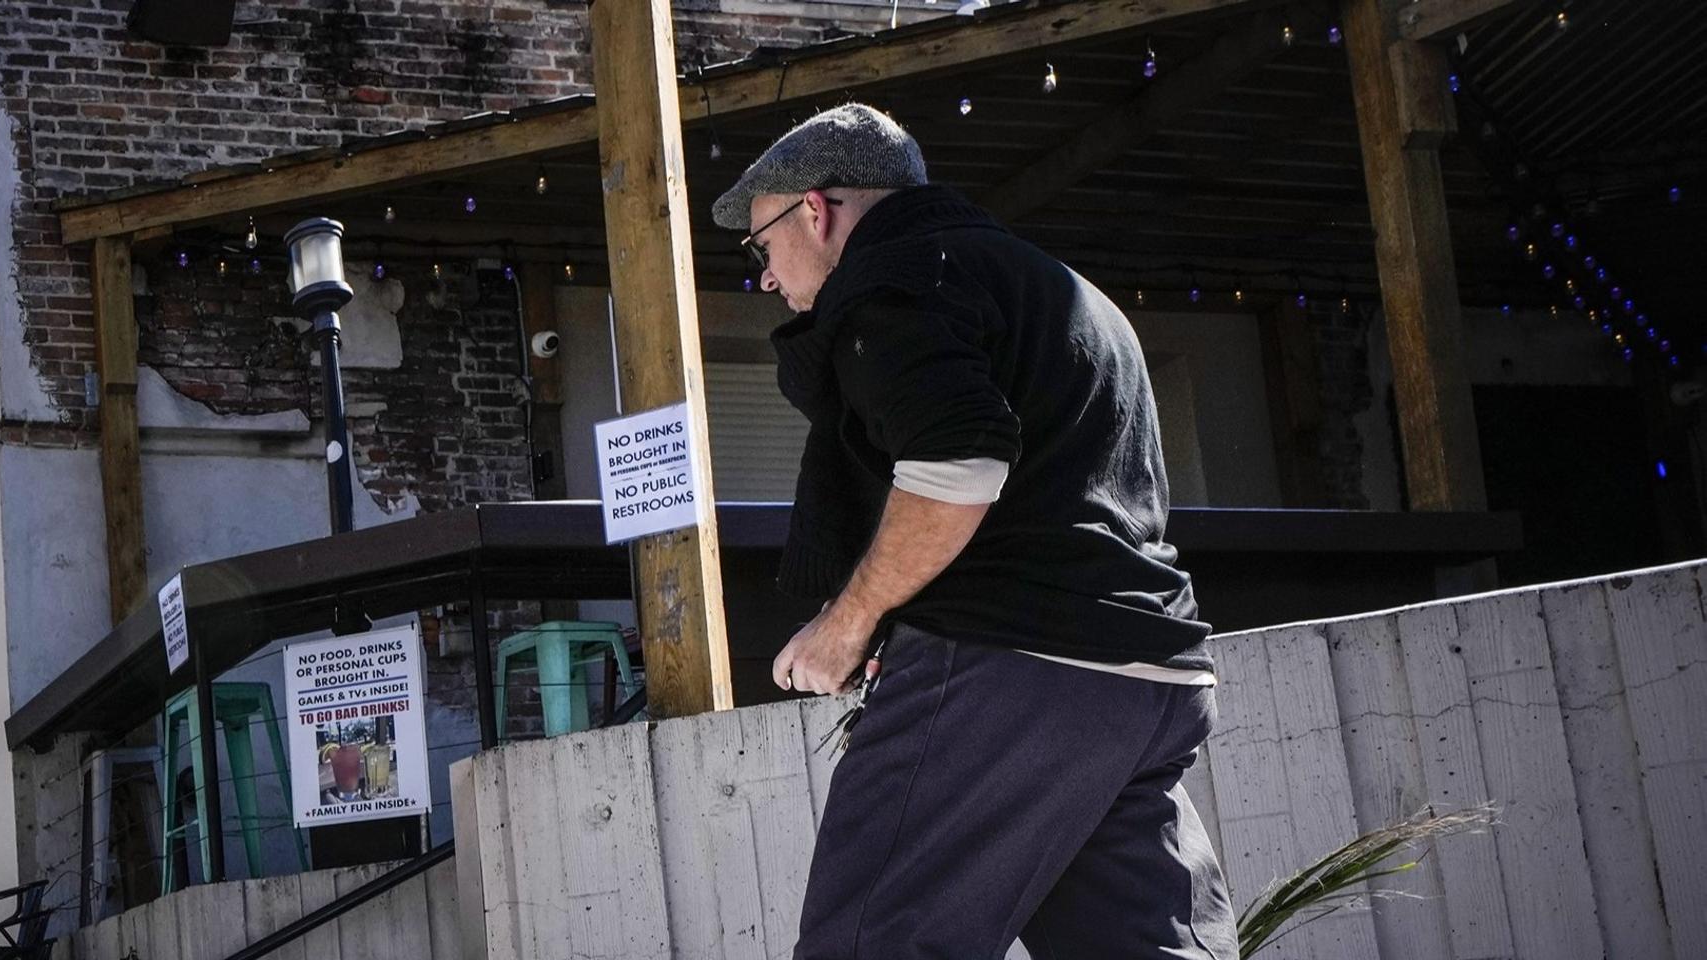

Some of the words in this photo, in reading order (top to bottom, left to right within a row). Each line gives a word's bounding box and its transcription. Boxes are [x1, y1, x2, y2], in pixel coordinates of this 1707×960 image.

[608, 435, 631, 450] NO
[635, 421, 683, 443] DRINKS
[609, 444, 668, 468] BROUGHT
[672, 440, 686, 452] IN
[615, 485, 638, 500] NO
[642, 473, 687, 494] PUBLIC
[612, 490, 694, 519] RESTROOMS
[299, 654, 317, 665] NO
[320, 648, 355, 662] FOOD,
[359, 640, 403, 656] DRINKS
[296, 667, 312, 678] OR
[316, 658, 374, 675] PERSONAL
[378, 653, 407, 666] CUPS
[315, 671, 369, 688] BROUGHT
[372, 668, 389, 679] IN.
[298, 693, 334, 706] GAMES
[338, 691, 345, 701] &
[348, 688, 367, 699] TVs
[370, 682, 408, 696] INSIDE!
[299, 713, 314, 725] TO
[317, 709, 332, 723] GO
[335, 706, 358, 721] BAR
[361, 700, 410, 718] DRINKS!
[312, 806, 347, 817] FAMILY
[351, 802, 372, 813] FUN
[375, 799, 410, 810] INSIDE
